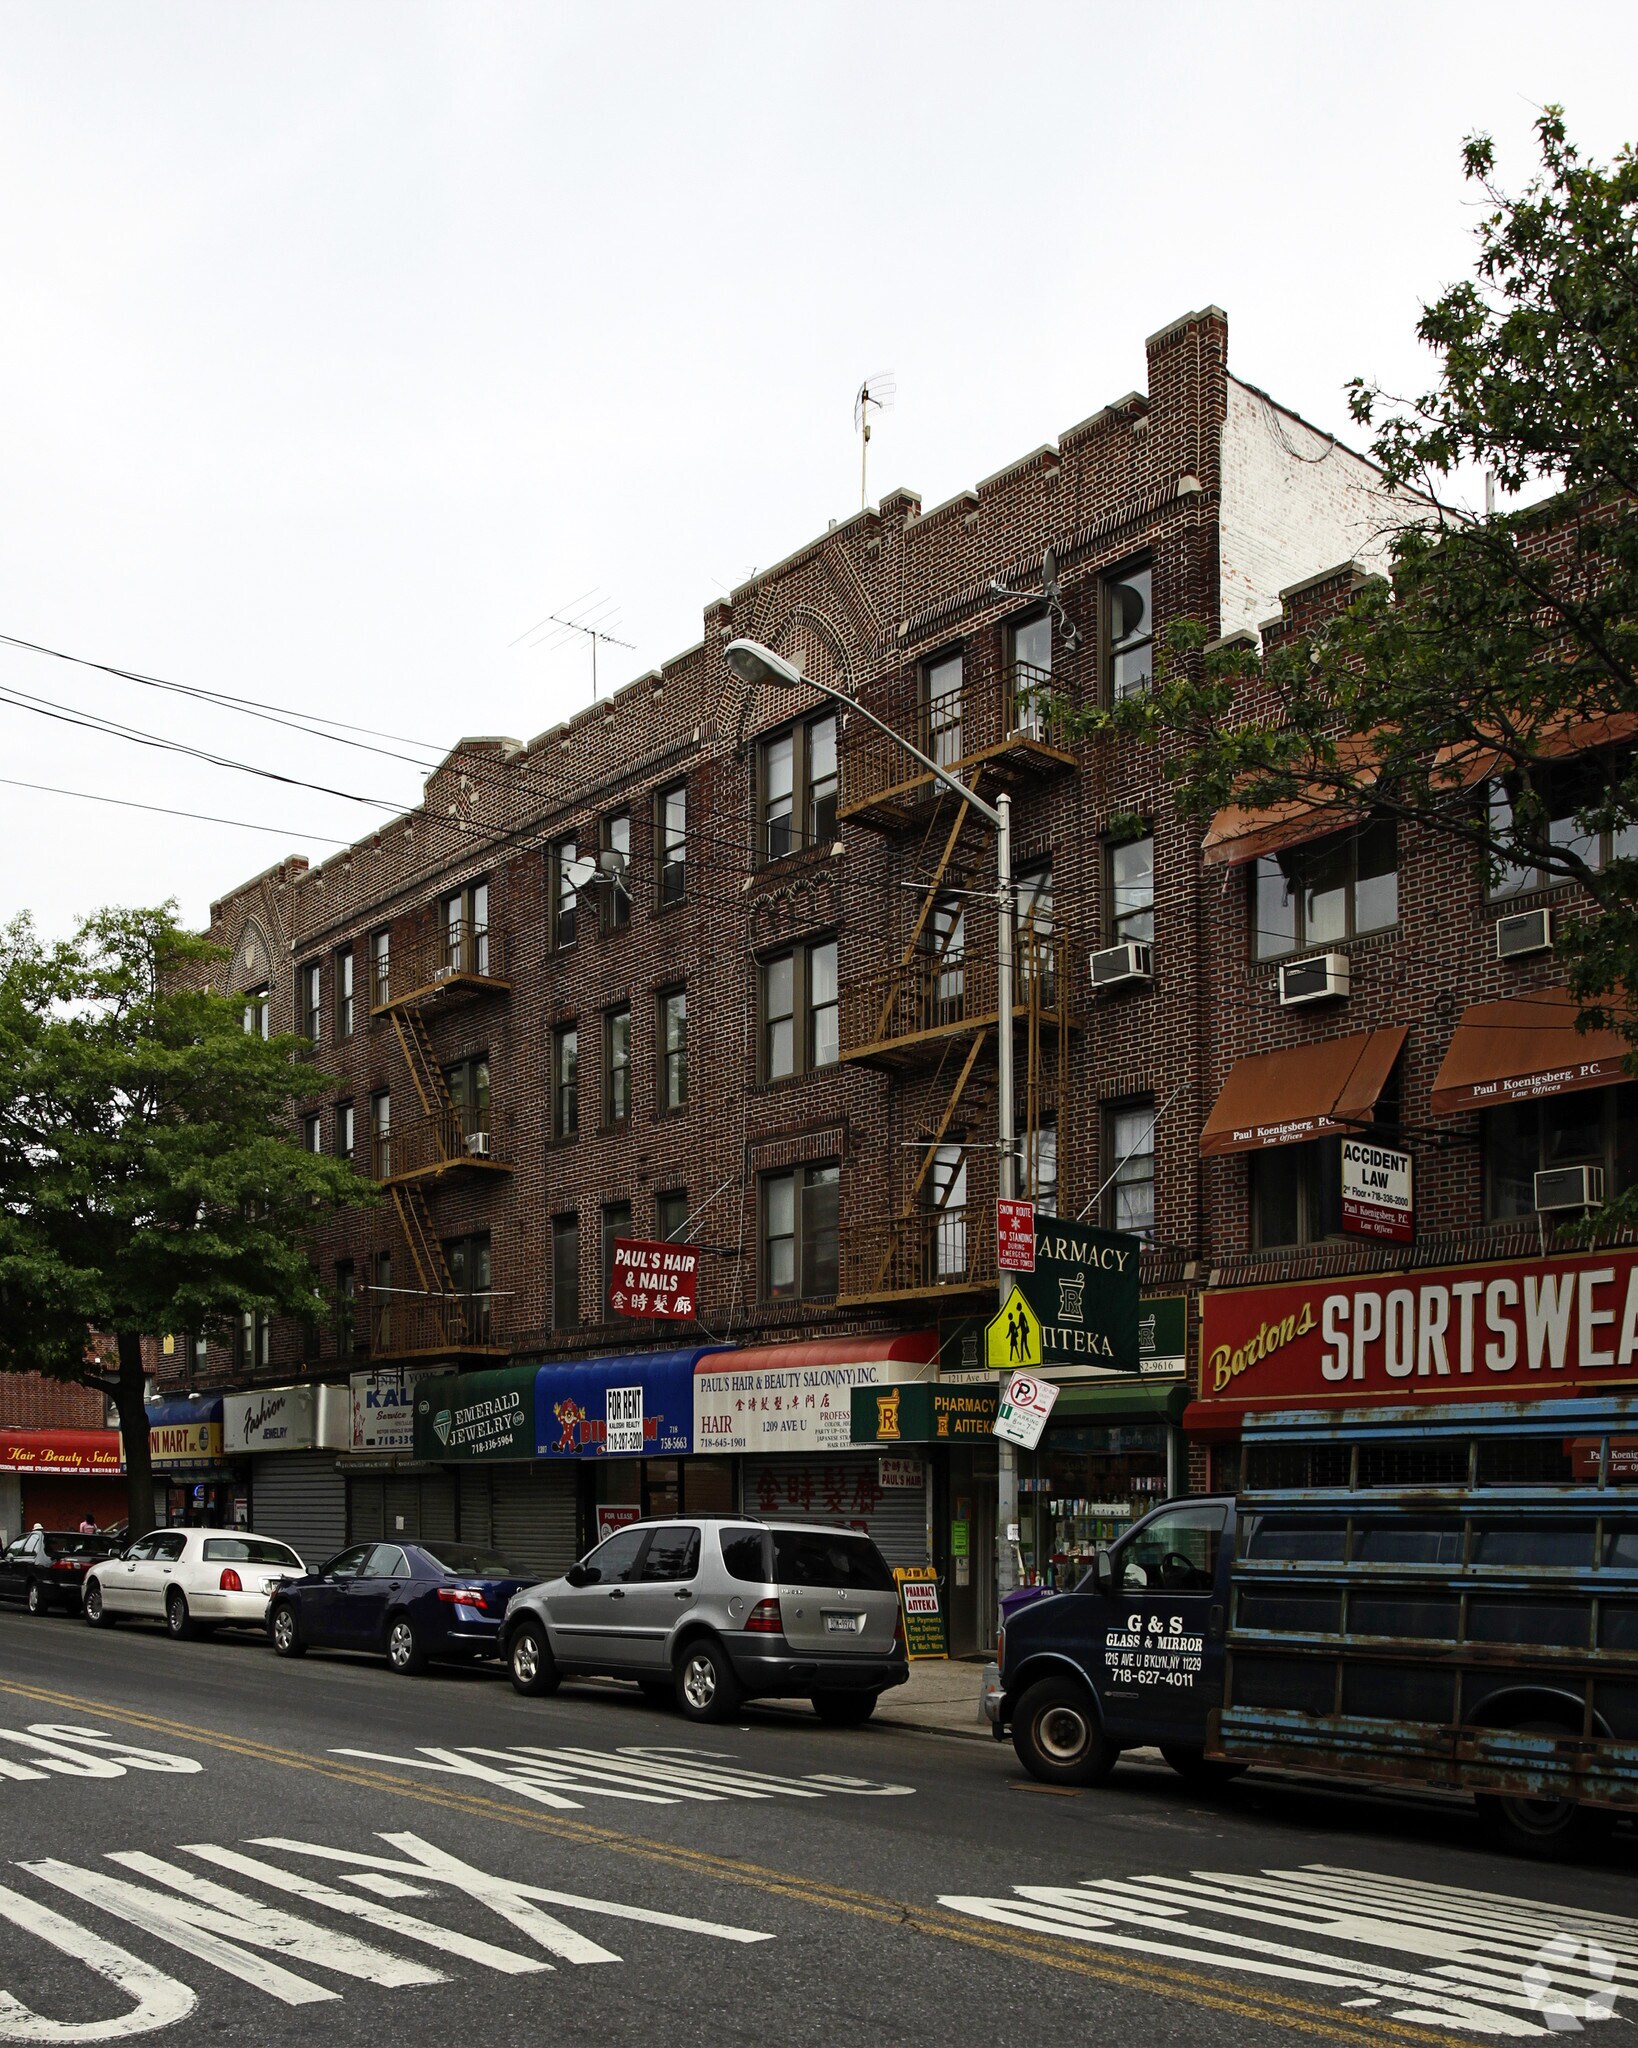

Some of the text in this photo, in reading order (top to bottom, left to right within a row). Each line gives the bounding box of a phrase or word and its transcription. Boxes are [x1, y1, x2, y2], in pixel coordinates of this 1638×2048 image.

[1473, 1063, 1601, 1096] Paul Koenigsberg, P.C.
[1511, 1084, 1561, 1098] Law Offices
[1233, 1130, 1252, 1141] Paul
[1257, 1121, 1314, 1137] Koenigsberg,
[1279, 1133, 1303, 1143] Offices
[1343, 1144, 1408, 1173] ACCIDENT
[1362, 1168, 1389, 1189] LAW
[1352, 1186, 1366, 1198] Floor
[1371, 1191, 1409, 1207] 718-336-2000
[999, 1204, 1031, 1218] SNOW ROUTE
[1344, 1202, 1358, 1214] Paul
[1398, 1213, 1409, 1224] P.C.
[1360, 1221, 1393, 1234] Law Offices
[999, 1231, 1033, 1244] NO STANDING
[1007, 1242, 1025, 1250] DURING
[615, 1248, 695, 1272] PAUL'S HAIR
[1002, 1250, 1030, 1259] EMERGENCY
[1033, 1233, 1130, 1272] ARMACY
[1000, 1258, 1018, 1266] VEHICLES
[625, 1271, 679, 1292] & NAILS
[1041, 1326, 1114, 1357] ПТЕКА
[1208, 1302, 1319, 1392] Bartons
[701, 1367, 879, 1392] PAUL'S HAIR & BEAUTY SALON(NY) INC.
[948, 1375, 963, 1383] 1211
[966, 1374, 981, 1382] Ave.
[454, 1391, 520, 1426] EMERALD
[608, 1389, 641, 1420] FOR RENT
[934, 1396, 995, 1413] PHARMACY
[243, 1396, 286, 1445] Fashion
[376, 1411, 407, 1420] Service
[701, 1415, 732, 1434] HAIR
[1013, 1411, 1040, 1426] PARKING
[263, 1427, 287, 1440] JEWELRY
[449, 1413, 512, 1446] JEWELRY
[762, 1420, 807, 1432] 1209 AVE U
[162, 1429, 189, 1454] MART
[471, 1433, 513, 1454] 718-336-5964
[660, 1437, 687, 1450] 758-5663
[700, 1438, 746, 1447] 718-645-1901
[7, 1447, 118, 1466] Hair Beauty Salon
[1612, 1463, 1628, 1471] Law
[905, 1475, 921, 1487] HAIR
[617, 1512, 633, 1520] LEASE
[905, 1586, 935, 1598] PHARMACY
[908, 1599, 937, 1611] АПТЕКА
[922, 1625, 940, 1633] Delivery
[1127, 1614, 1183, 1634] G & S
[908, 1634, 945, 1642] Surgical Supplies
[931, 1641, 944, 1649] More
[1106, 1633, 1203, 1652] GLASS & MIRROR
[1105, 1652, 1119, 1666] 1215
[1120, 1653, 1135, 1667] AVE.
[1136, 1654, 1142, 1667] U
[1182, 1656, 1202, 1671] 11229
[1112, 1668, 1193, 1687] 718-627-4011
